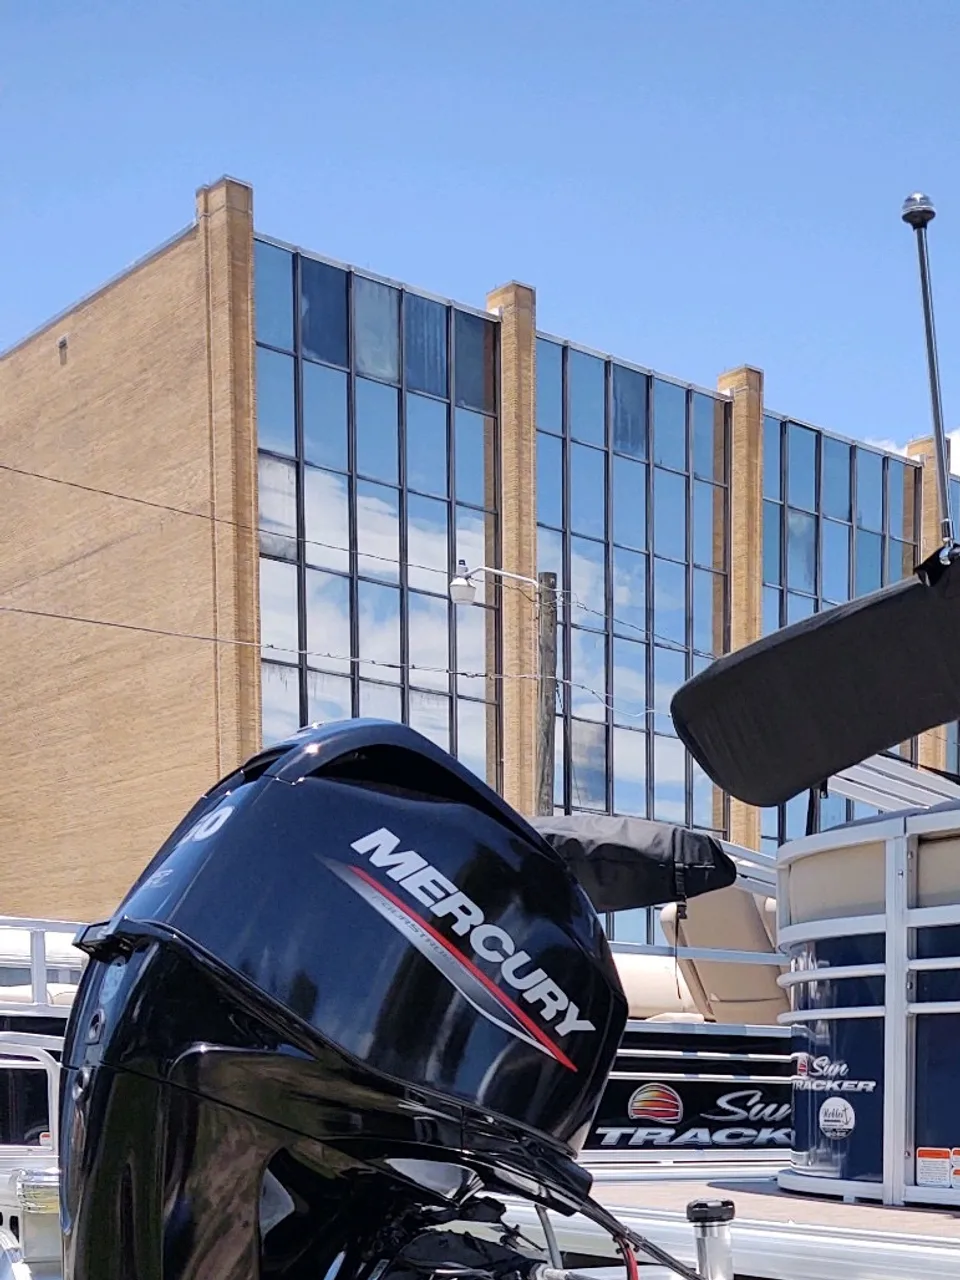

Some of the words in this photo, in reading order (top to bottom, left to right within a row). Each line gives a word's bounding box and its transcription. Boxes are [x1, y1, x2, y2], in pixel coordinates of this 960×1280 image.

[350, 827, 596, 1037] MERCURY
[808, 1055, 849, 1077] Sun
[793, 1080, 877, 1093] TRACKER
